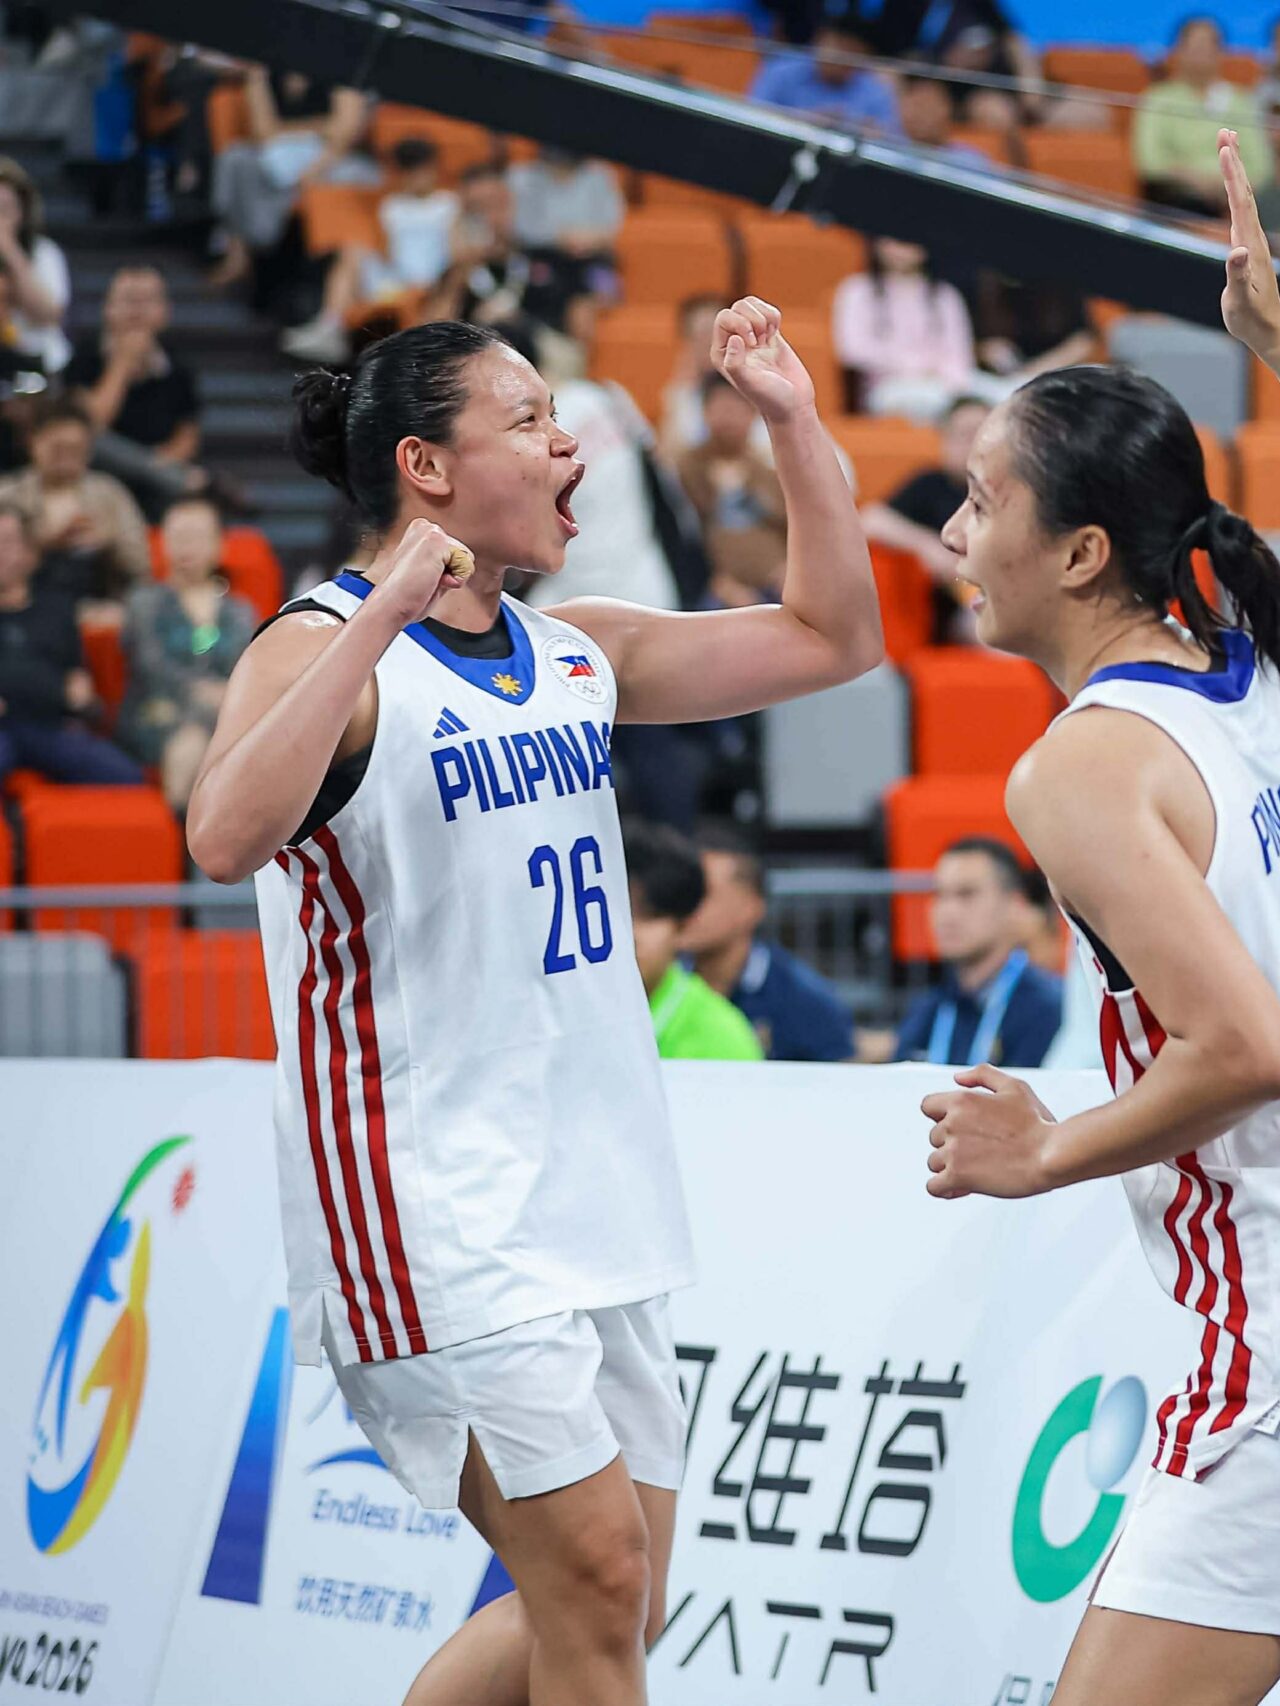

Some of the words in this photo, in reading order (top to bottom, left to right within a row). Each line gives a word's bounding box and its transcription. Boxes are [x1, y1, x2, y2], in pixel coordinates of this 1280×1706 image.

[527, 836, 614, 975] 26
[313, 1489, 399, 1531] Endless
[405, 1503, 461, 1543] Love
[26, 1632, 99, 1696] 2026
